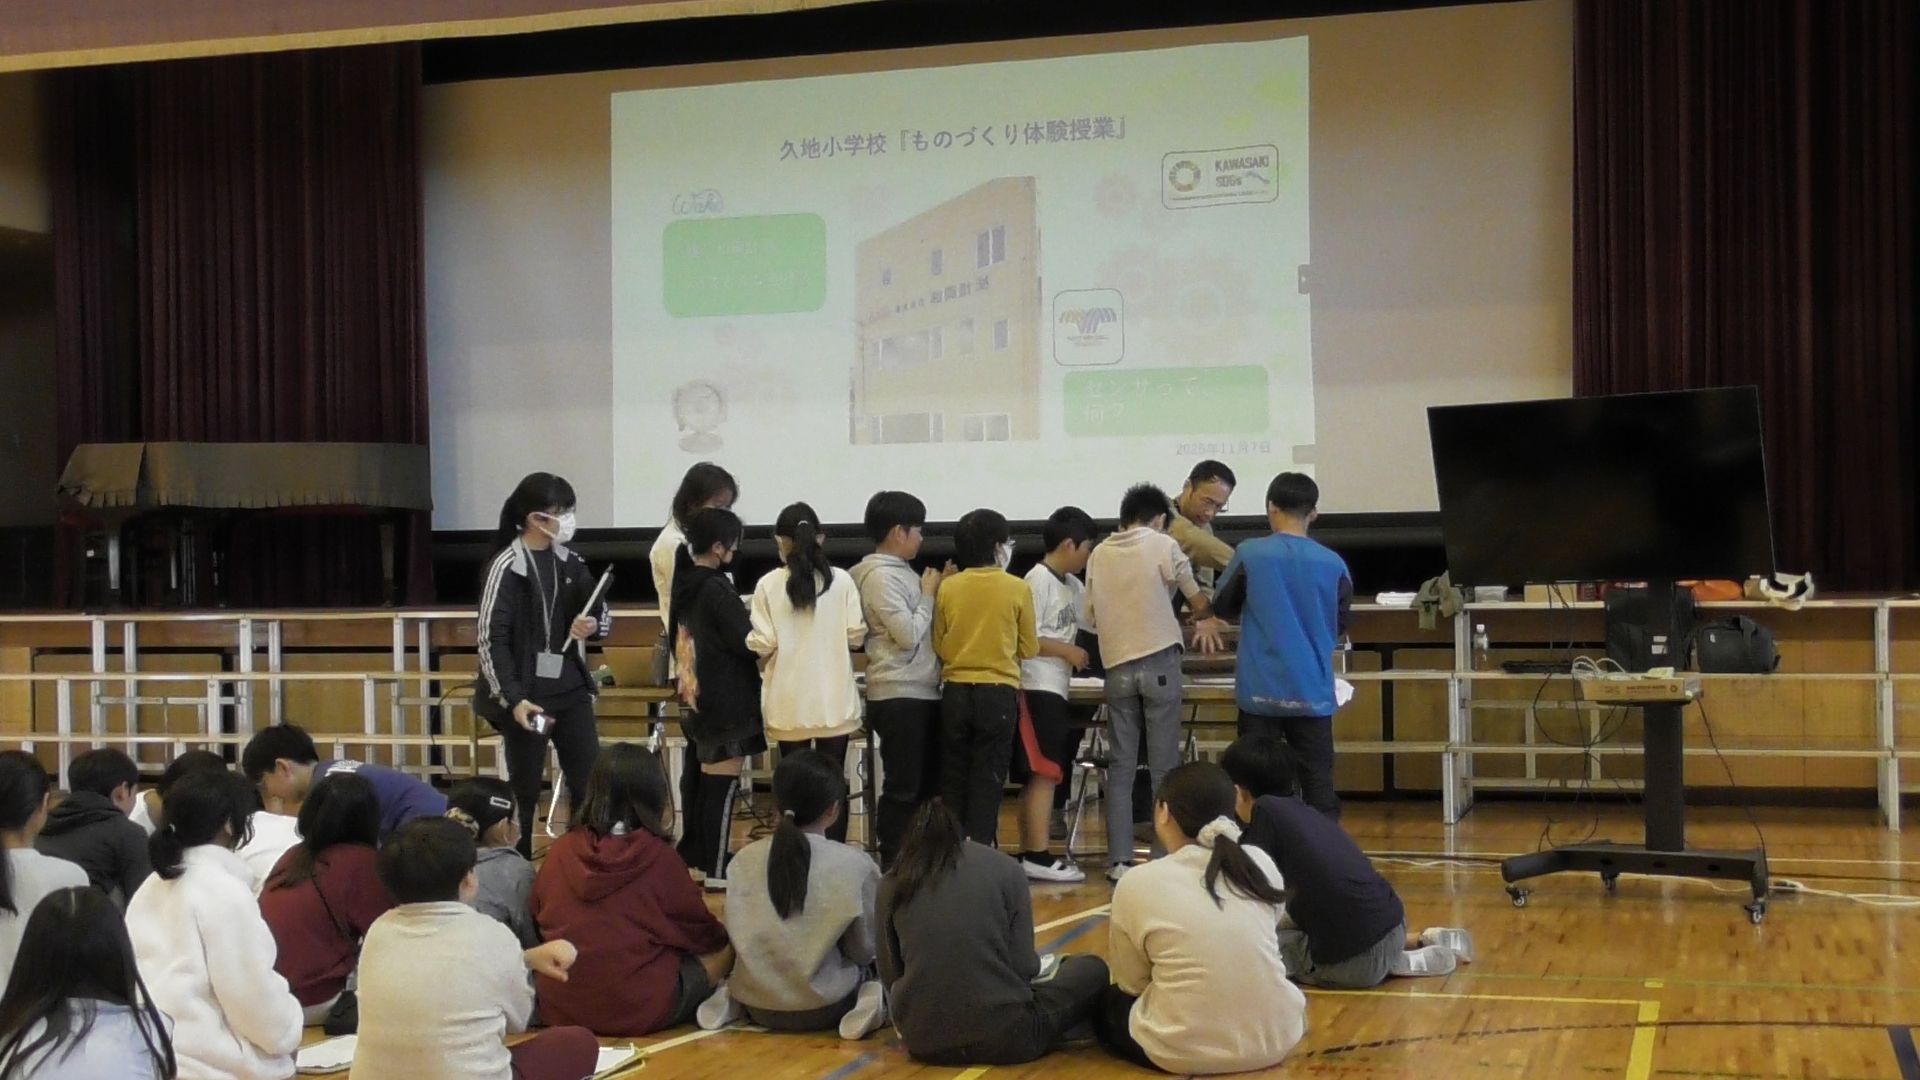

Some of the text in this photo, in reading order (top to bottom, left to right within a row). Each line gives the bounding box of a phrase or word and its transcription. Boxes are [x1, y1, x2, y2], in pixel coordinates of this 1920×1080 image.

[780, 115, 1127, 161] 久地小学校『ものづくり体験授業』
[1214, 155, 1270, 172] KAWASAKI
[1215, 174, 1242, 188] SDGs
